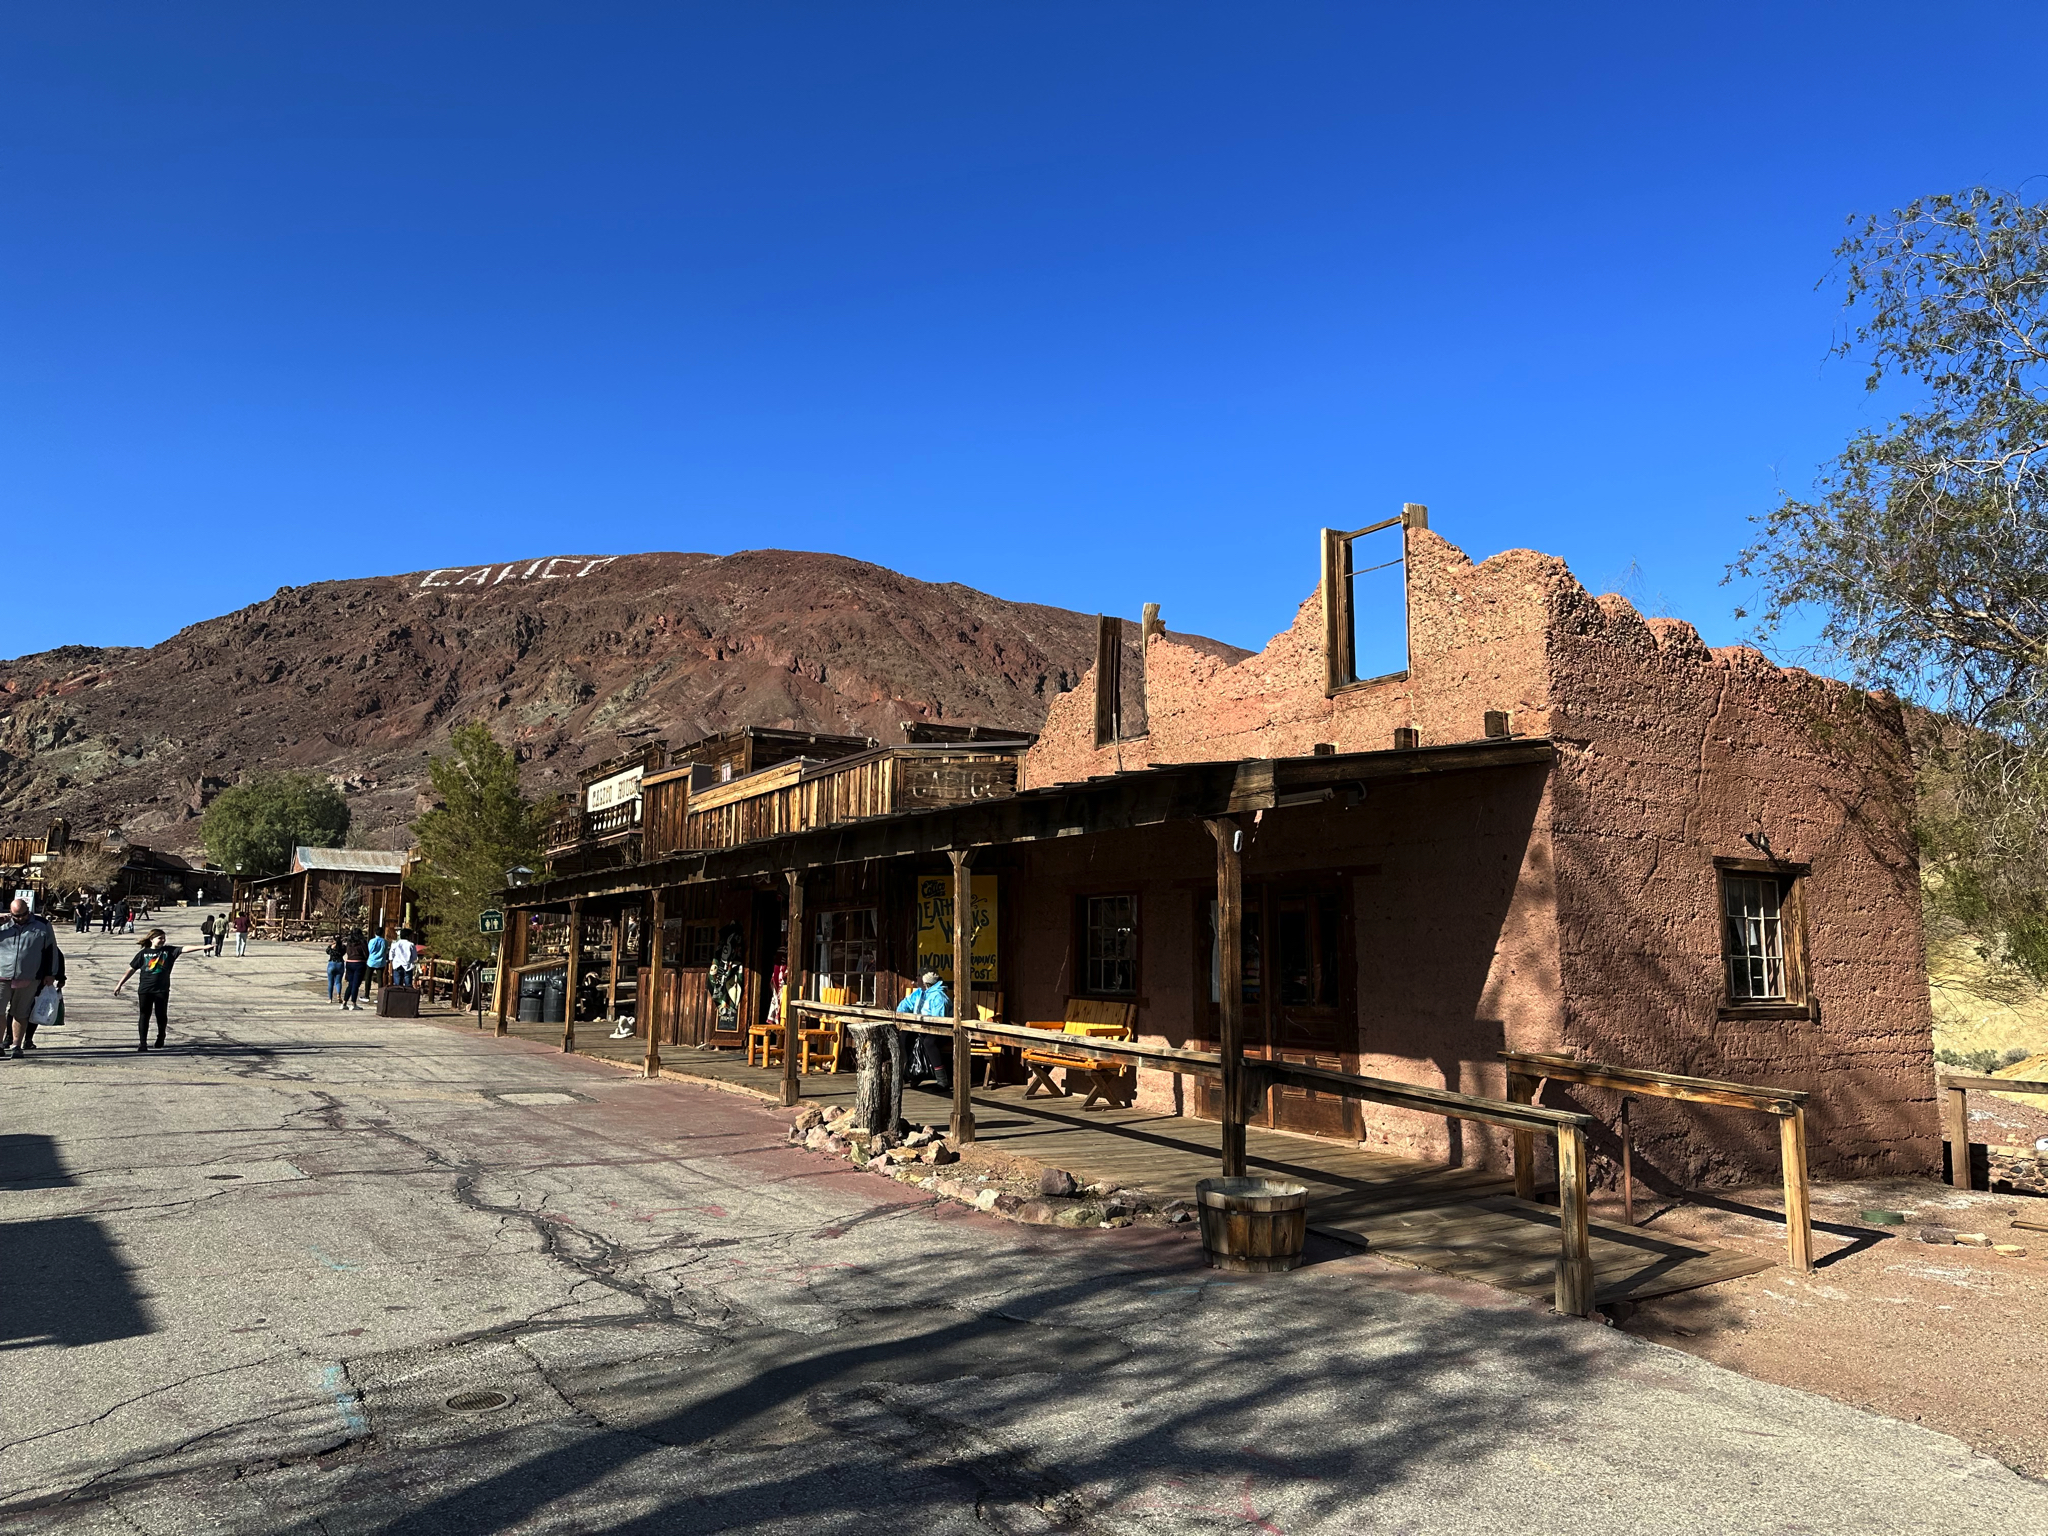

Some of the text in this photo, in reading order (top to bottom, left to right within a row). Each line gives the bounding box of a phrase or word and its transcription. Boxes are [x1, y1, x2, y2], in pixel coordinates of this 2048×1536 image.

[917, 897, 955, 932] LEATH
[938, 909, 990, 944] WKS
[970, 953, 996, 968] RADING
